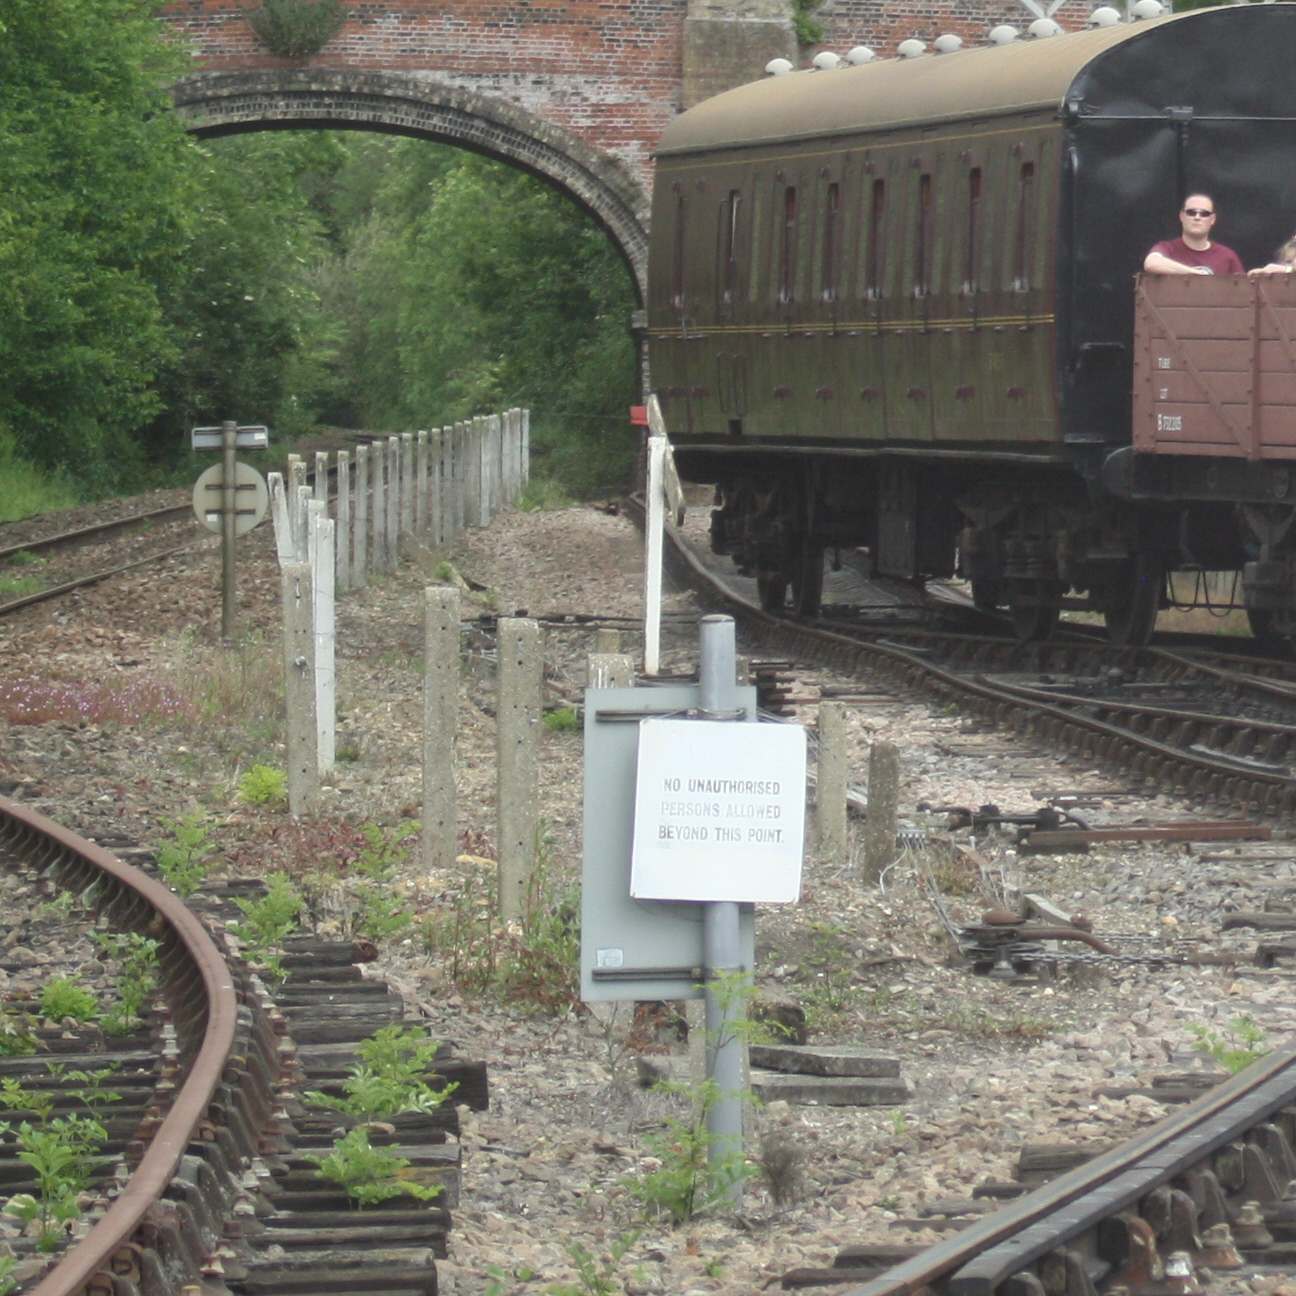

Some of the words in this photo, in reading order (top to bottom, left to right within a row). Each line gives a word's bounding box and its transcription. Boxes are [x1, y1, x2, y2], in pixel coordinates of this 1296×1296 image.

[664, 778, 681, 793] NO
[688, 778, 781, 796] UNAUTHORISED
[661, 801, 720, 818] PERSONS
[726, 803, 781, 819] ALLOWED
[658, 825, 708, 841] BEYOND
[714, 826, 742, 842] THIS
